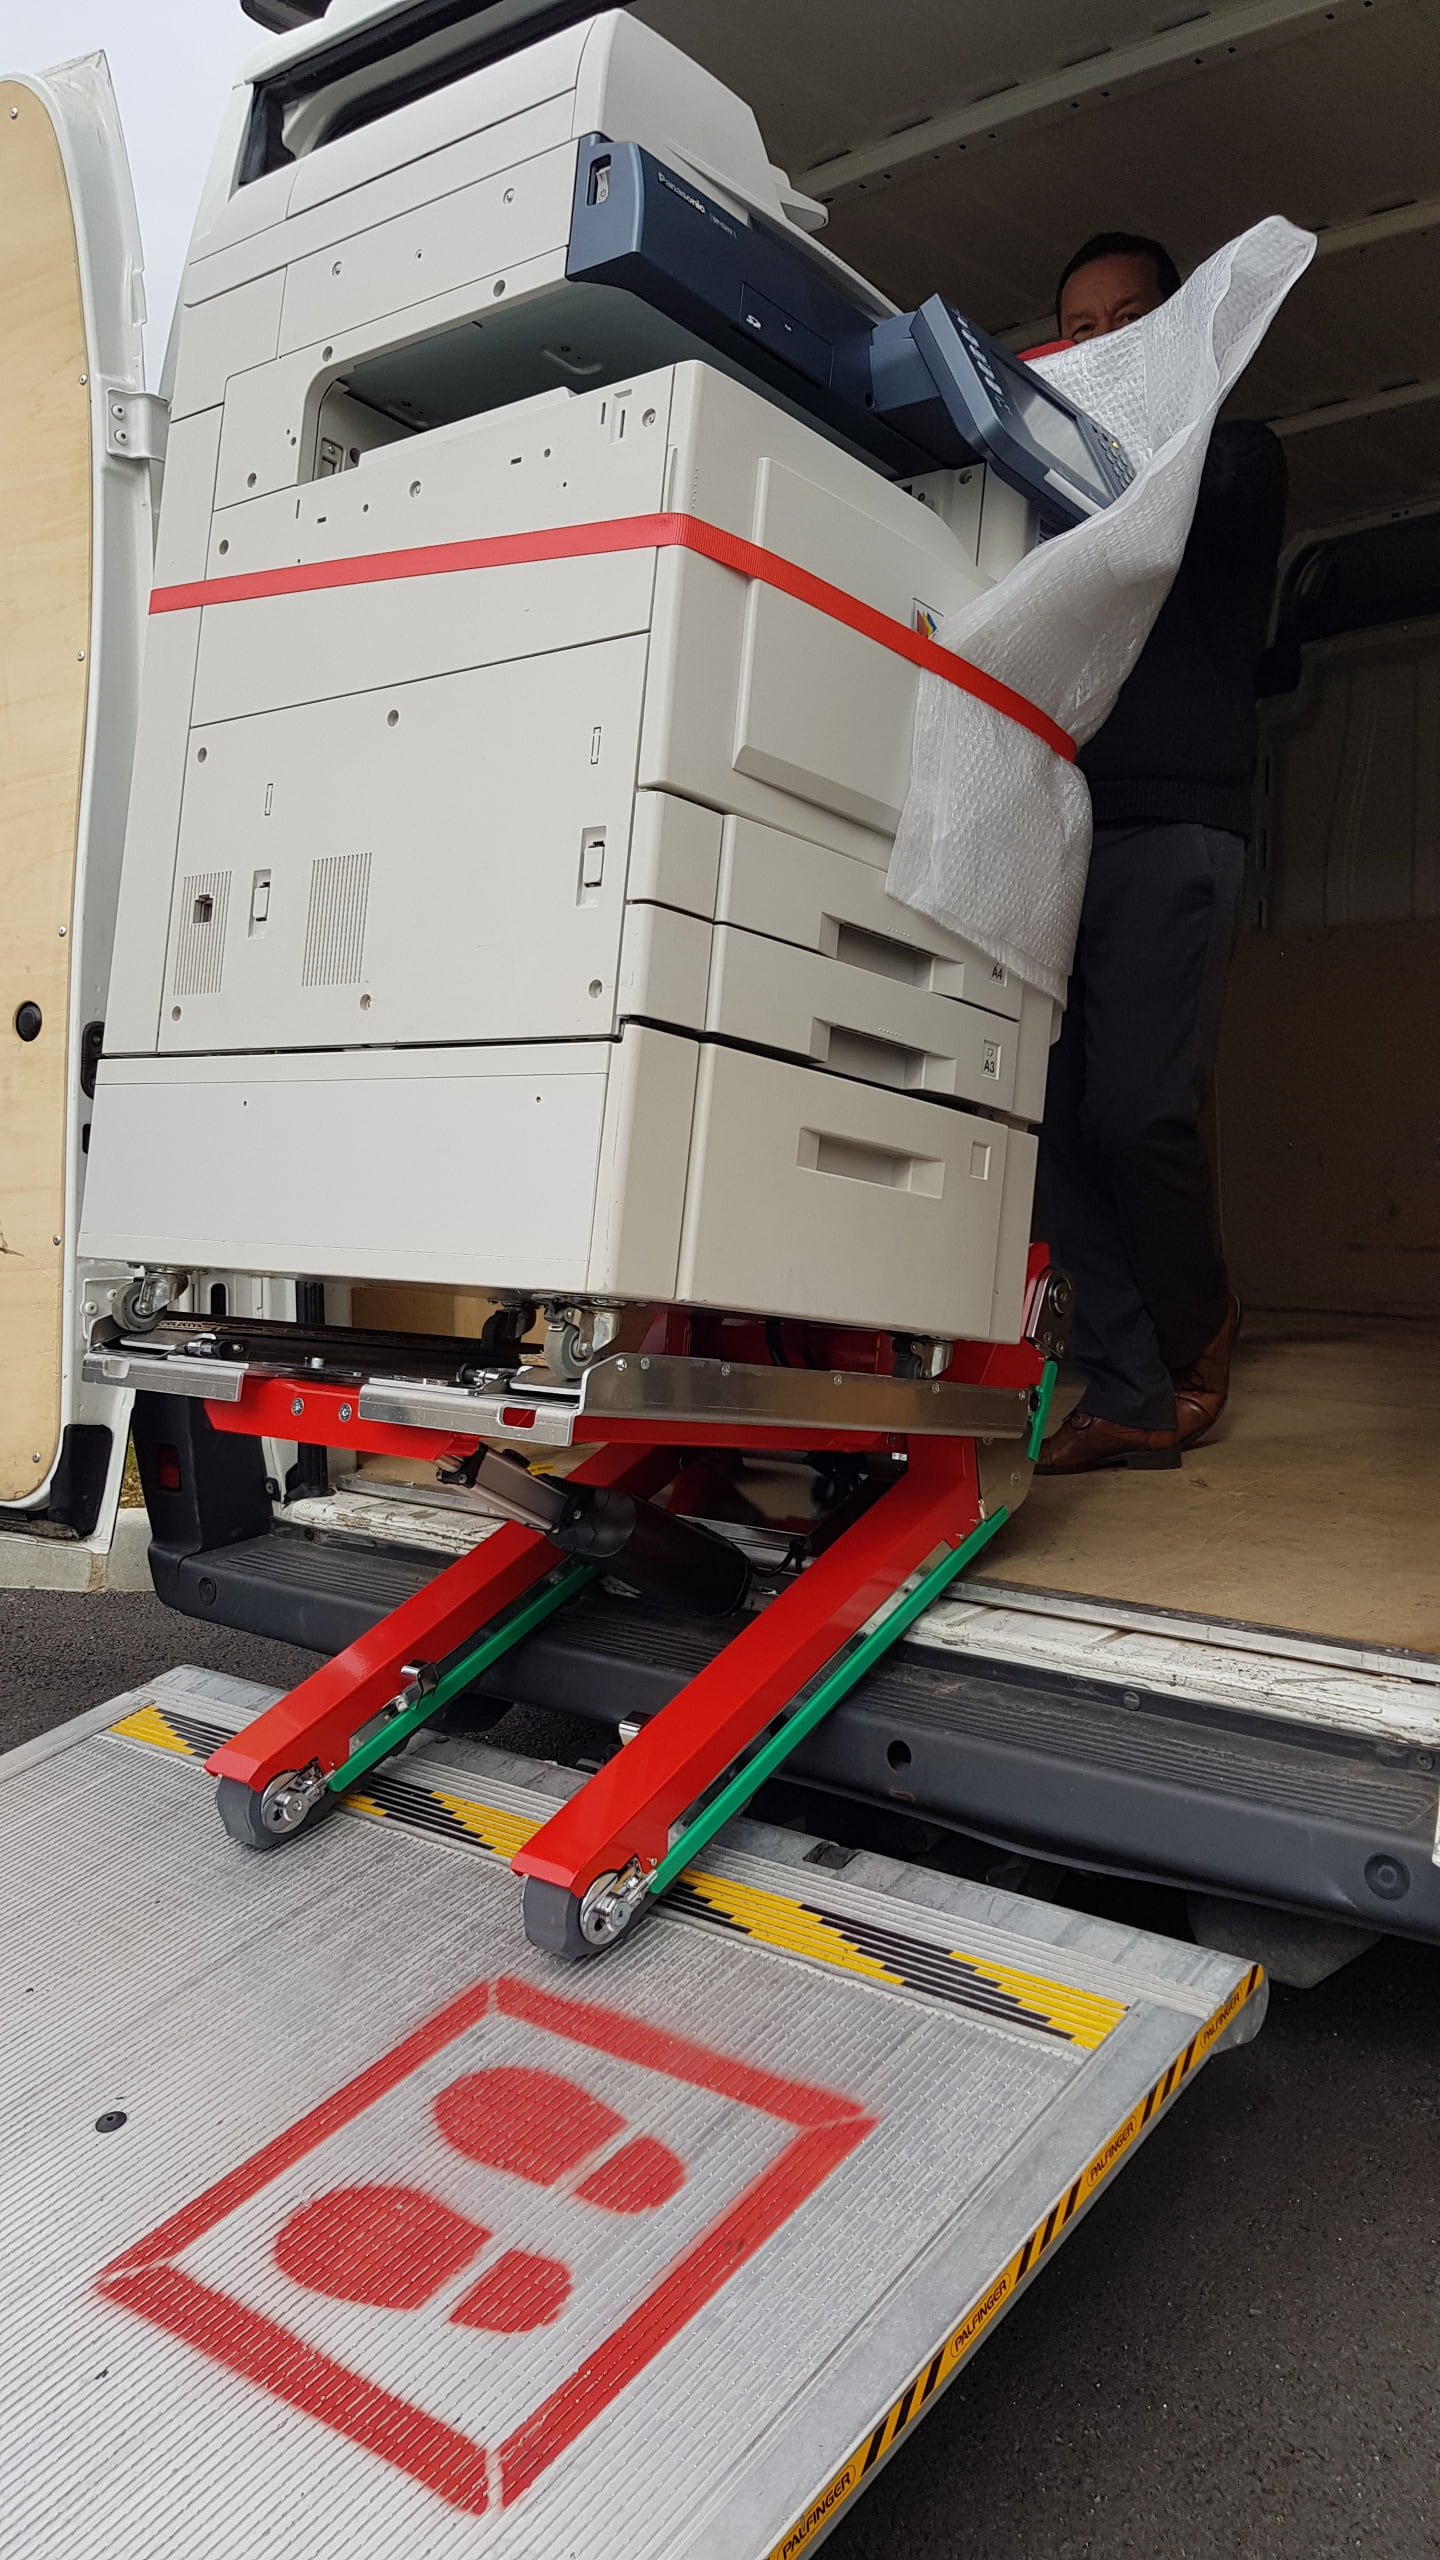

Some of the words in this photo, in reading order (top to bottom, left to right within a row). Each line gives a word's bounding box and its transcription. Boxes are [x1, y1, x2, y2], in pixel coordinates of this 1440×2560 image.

[657, 171, 705, 213] Panasonic
[991, 965, 1003, 980] A4
[983, 1059, 995, 1073] A3
[1090, 2121, 1134, 2182] PALFINGER
[955, 2279, 1007, 2352] PALFINGER
[782, 2471, 851, 2560] PALFINGER
